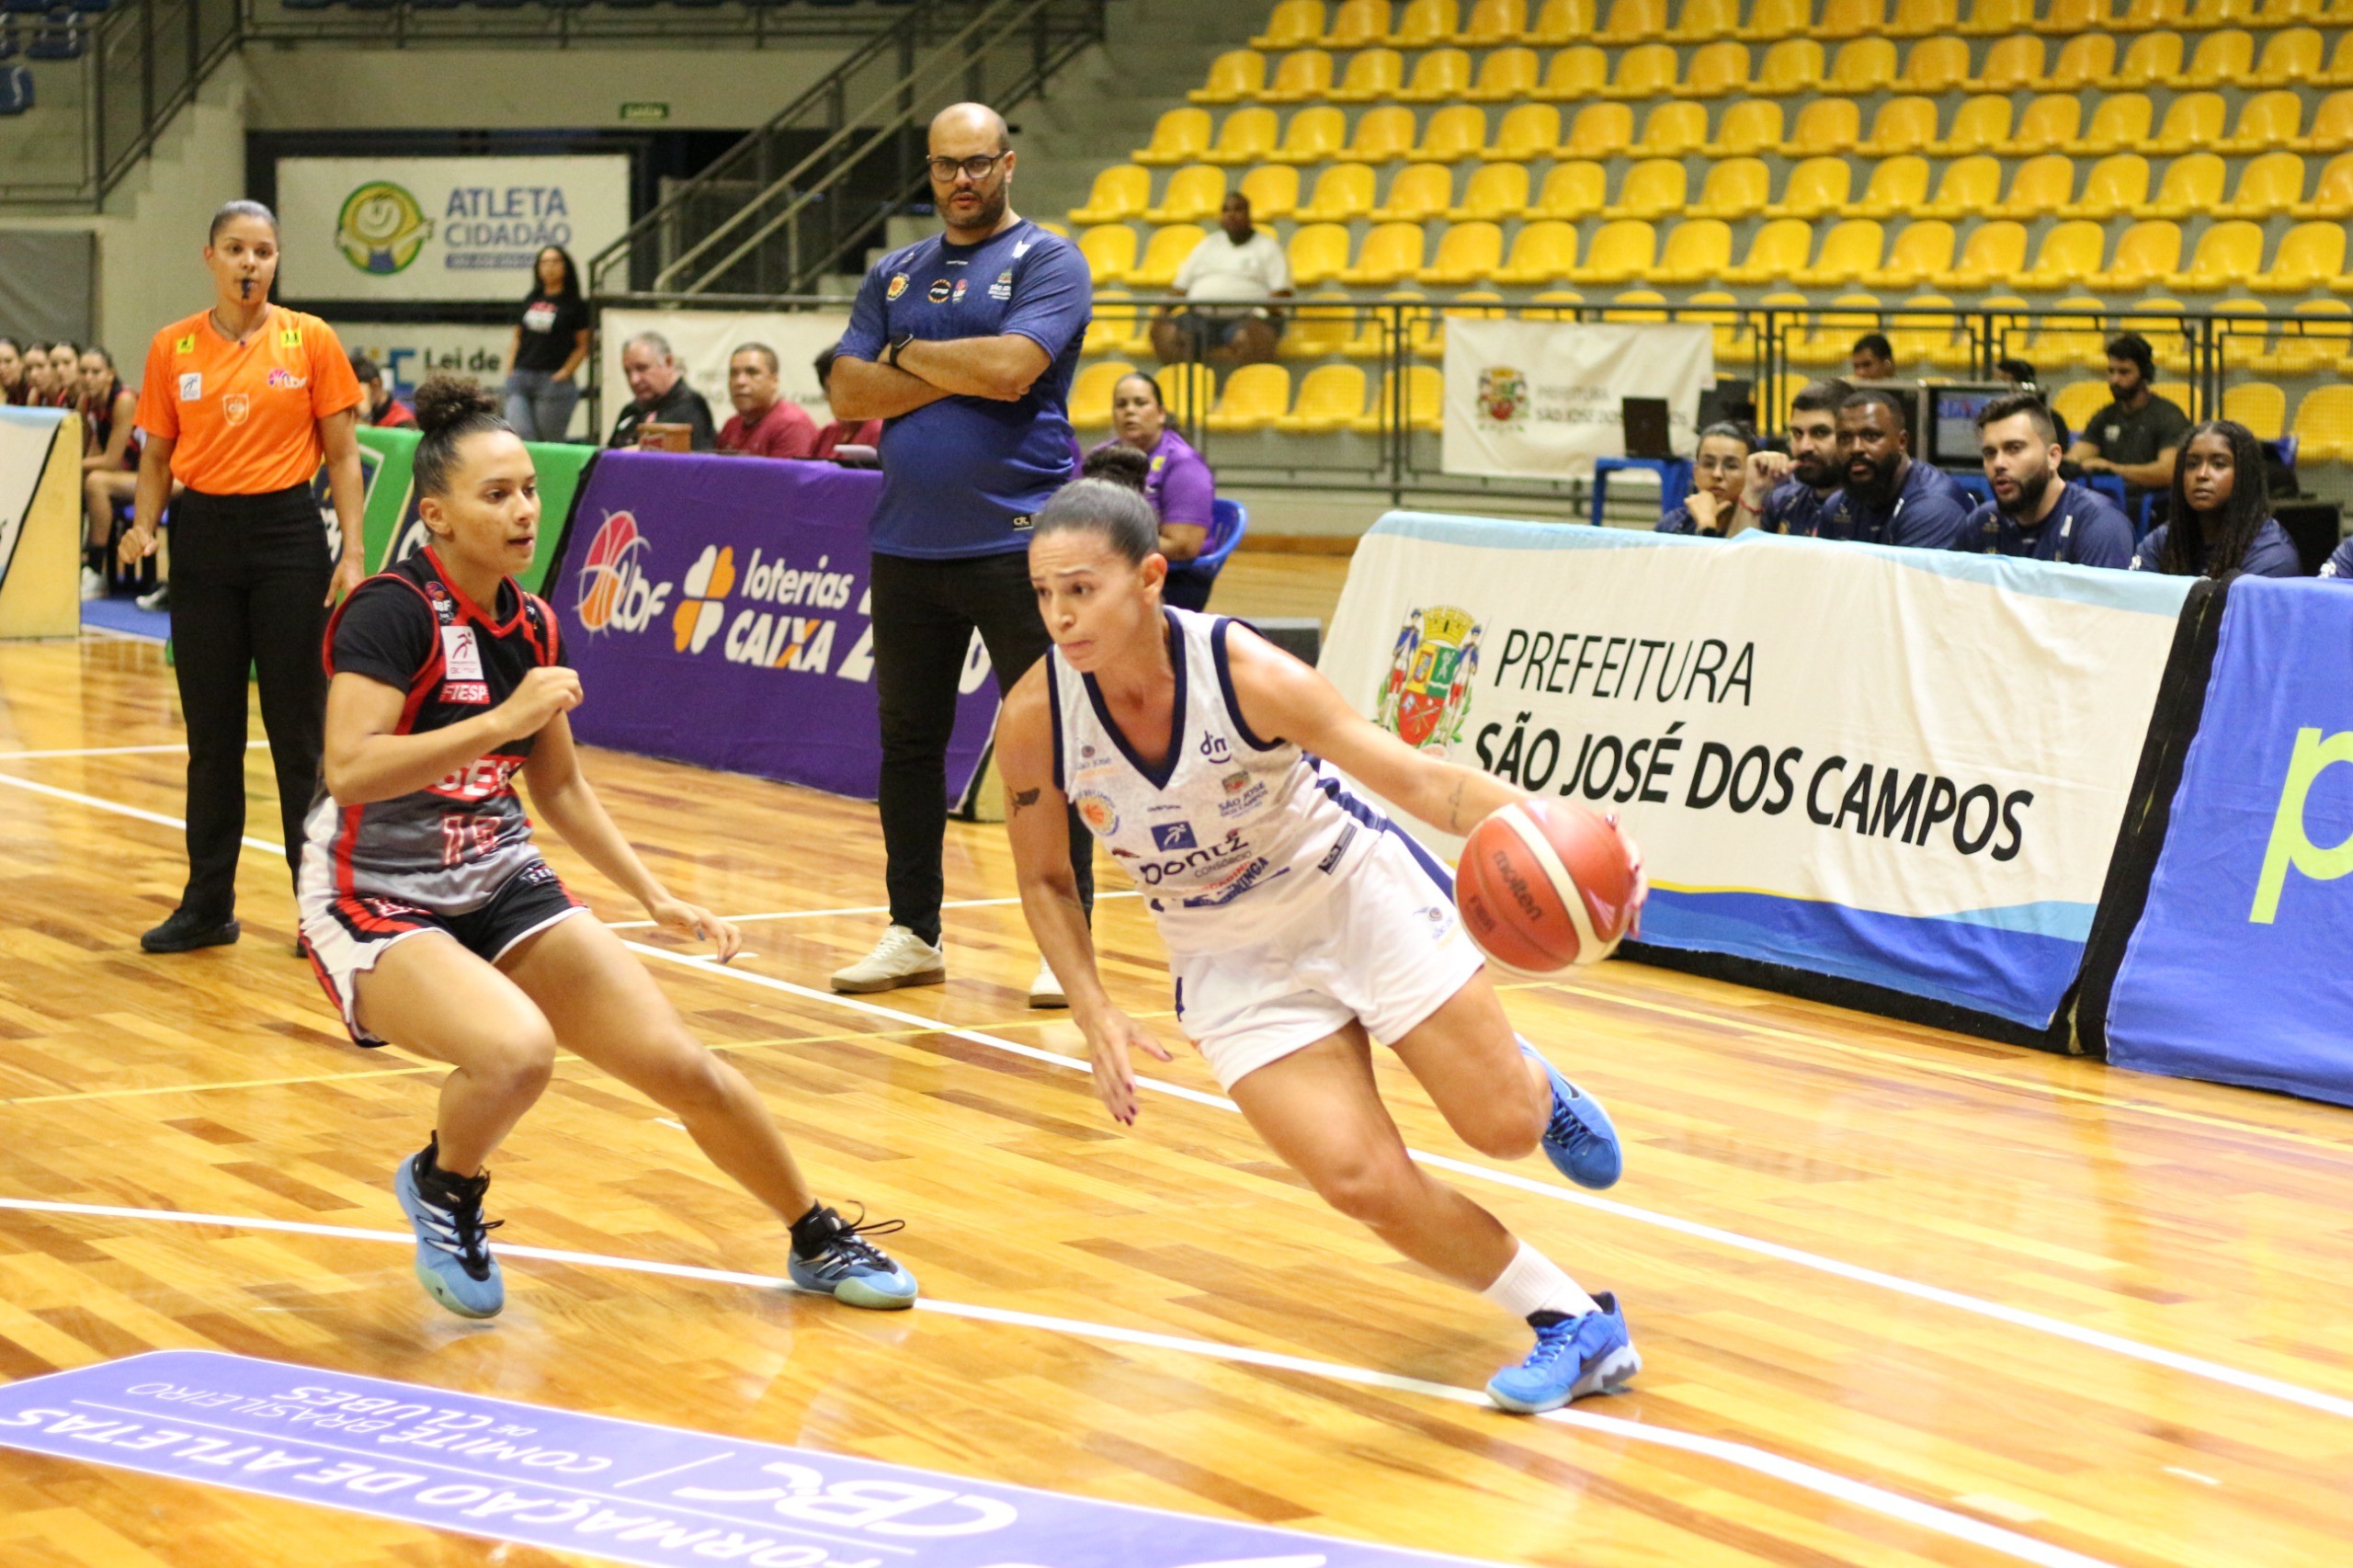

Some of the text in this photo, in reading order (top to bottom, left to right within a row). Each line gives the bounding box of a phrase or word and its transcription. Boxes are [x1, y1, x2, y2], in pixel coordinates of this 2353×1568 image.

[444, 220, 572, 246] CIDADÃO
[446, 187, 568, 218] ATLETA
[425, 346, 461, 369] Lei
[468, 347, 502, 369] de
[741, 548, 855, 610] loterias
[724, 609, 837, 674] CAIXA
[1495, 629, 1754, 706] PREFEITURA
[441, 684, 488, 701] FIESP
[1476, 711, 1561, 791] SÃO
[1560, 722, 1686, 804] JOSÉ
[1686, 741, 1803, 815] DOS
[1806, 756, 2035, 862] CAMPOS
[1493, 850, 1543, 922] molten
[0, 1408, 324, 1472] ATLETAS
[125, 1382, 613, 1472] COMITÊ BRASILEIRO
[271, 1386, 539, 1437] DE CLUBES
[291, 1461, 429, 1494] DE
[670, 1461, 1018, 1537] CBC
